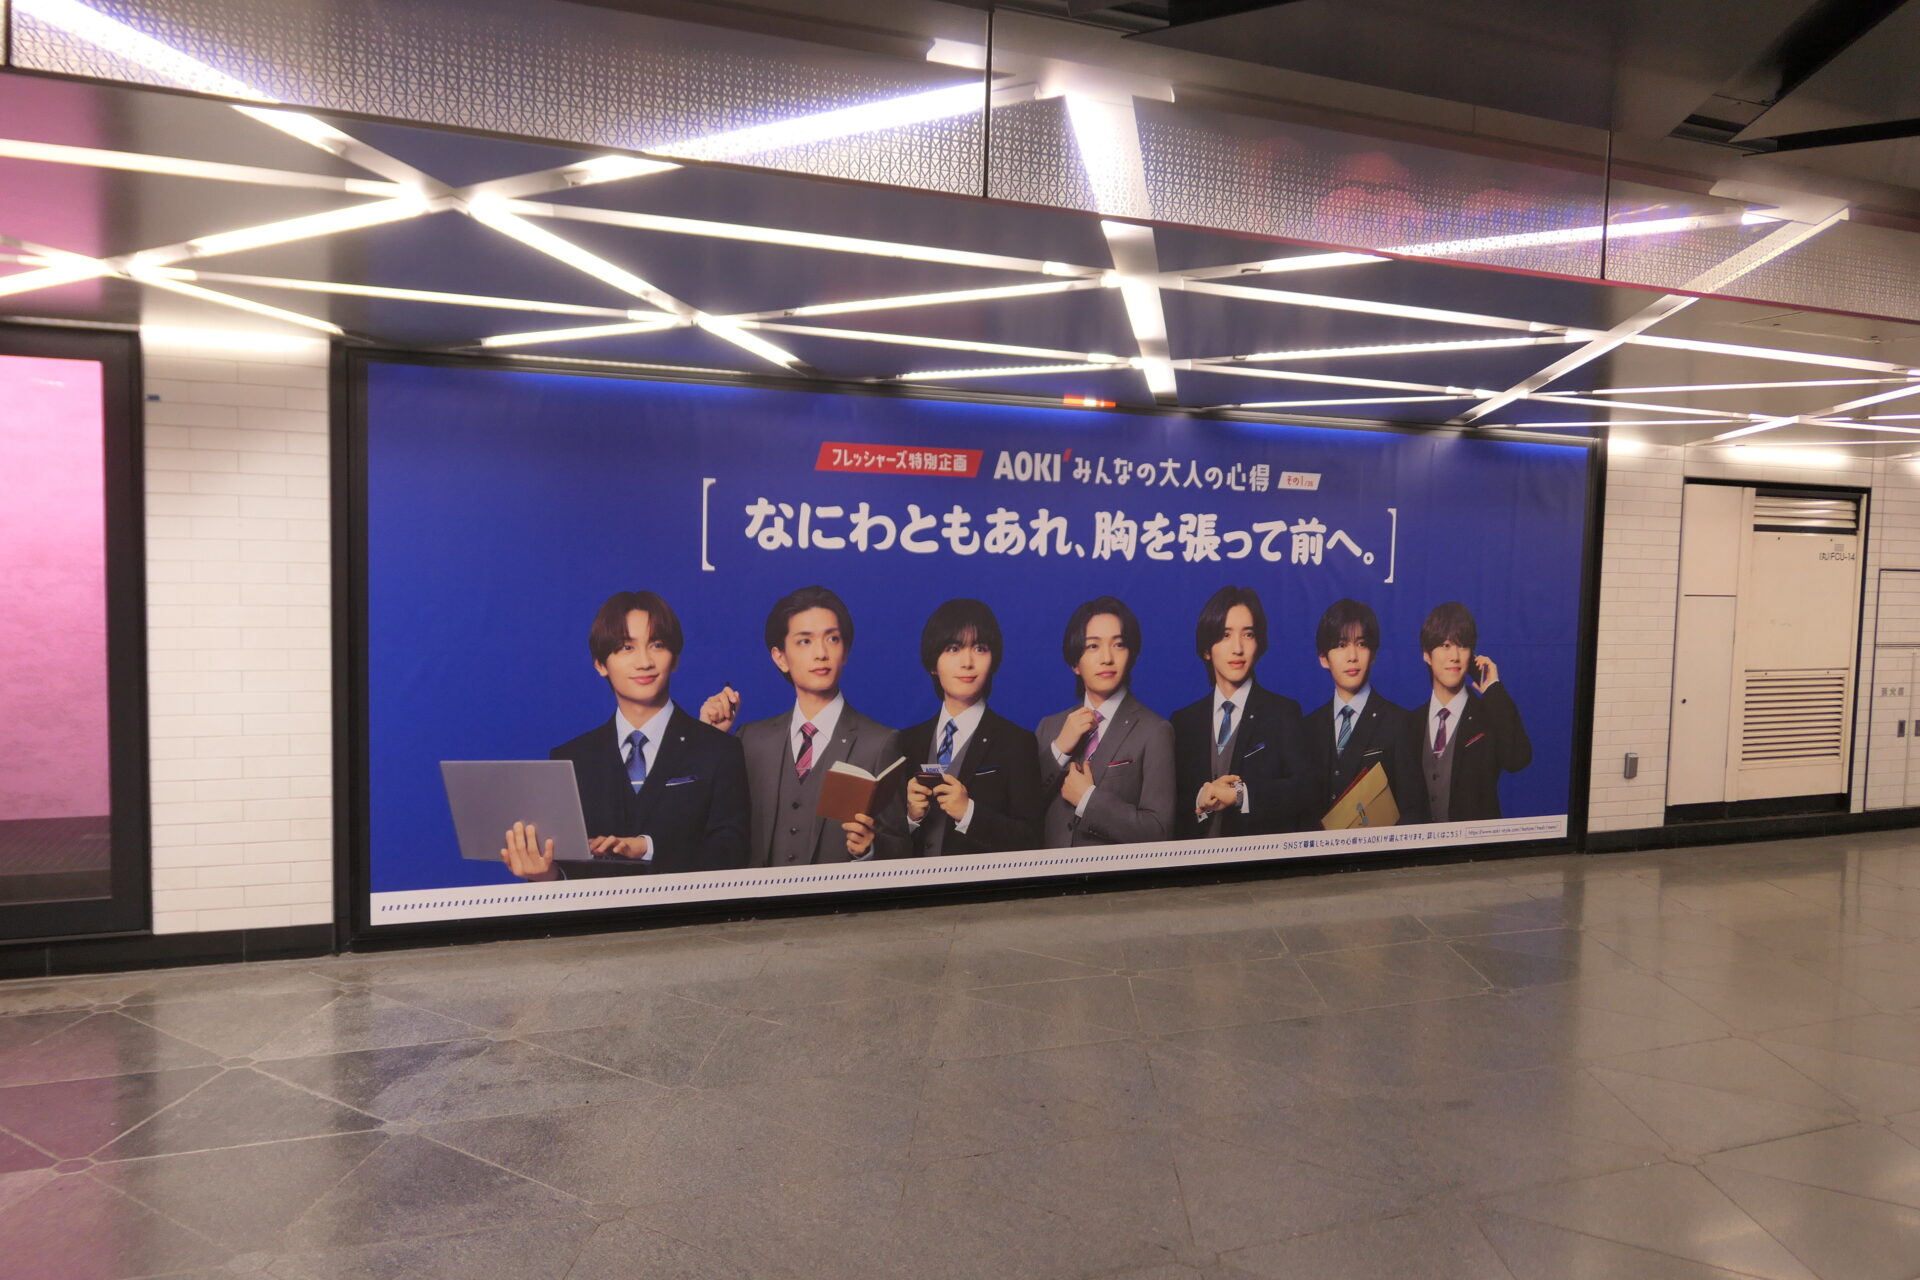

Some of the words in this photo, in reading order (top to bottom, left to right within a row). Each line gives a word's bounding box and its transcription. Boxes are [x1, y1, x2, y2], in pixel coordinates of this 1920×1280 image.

[832, 449, 967, 472] フレッシャーズ特別企画
[994, 450, 1061, 482] AOKI
[1072, 457, 1270, 492] みんなの大人の心得
[745, 497, 1374, 566] なにわともあれ、胸を張って前へ。
